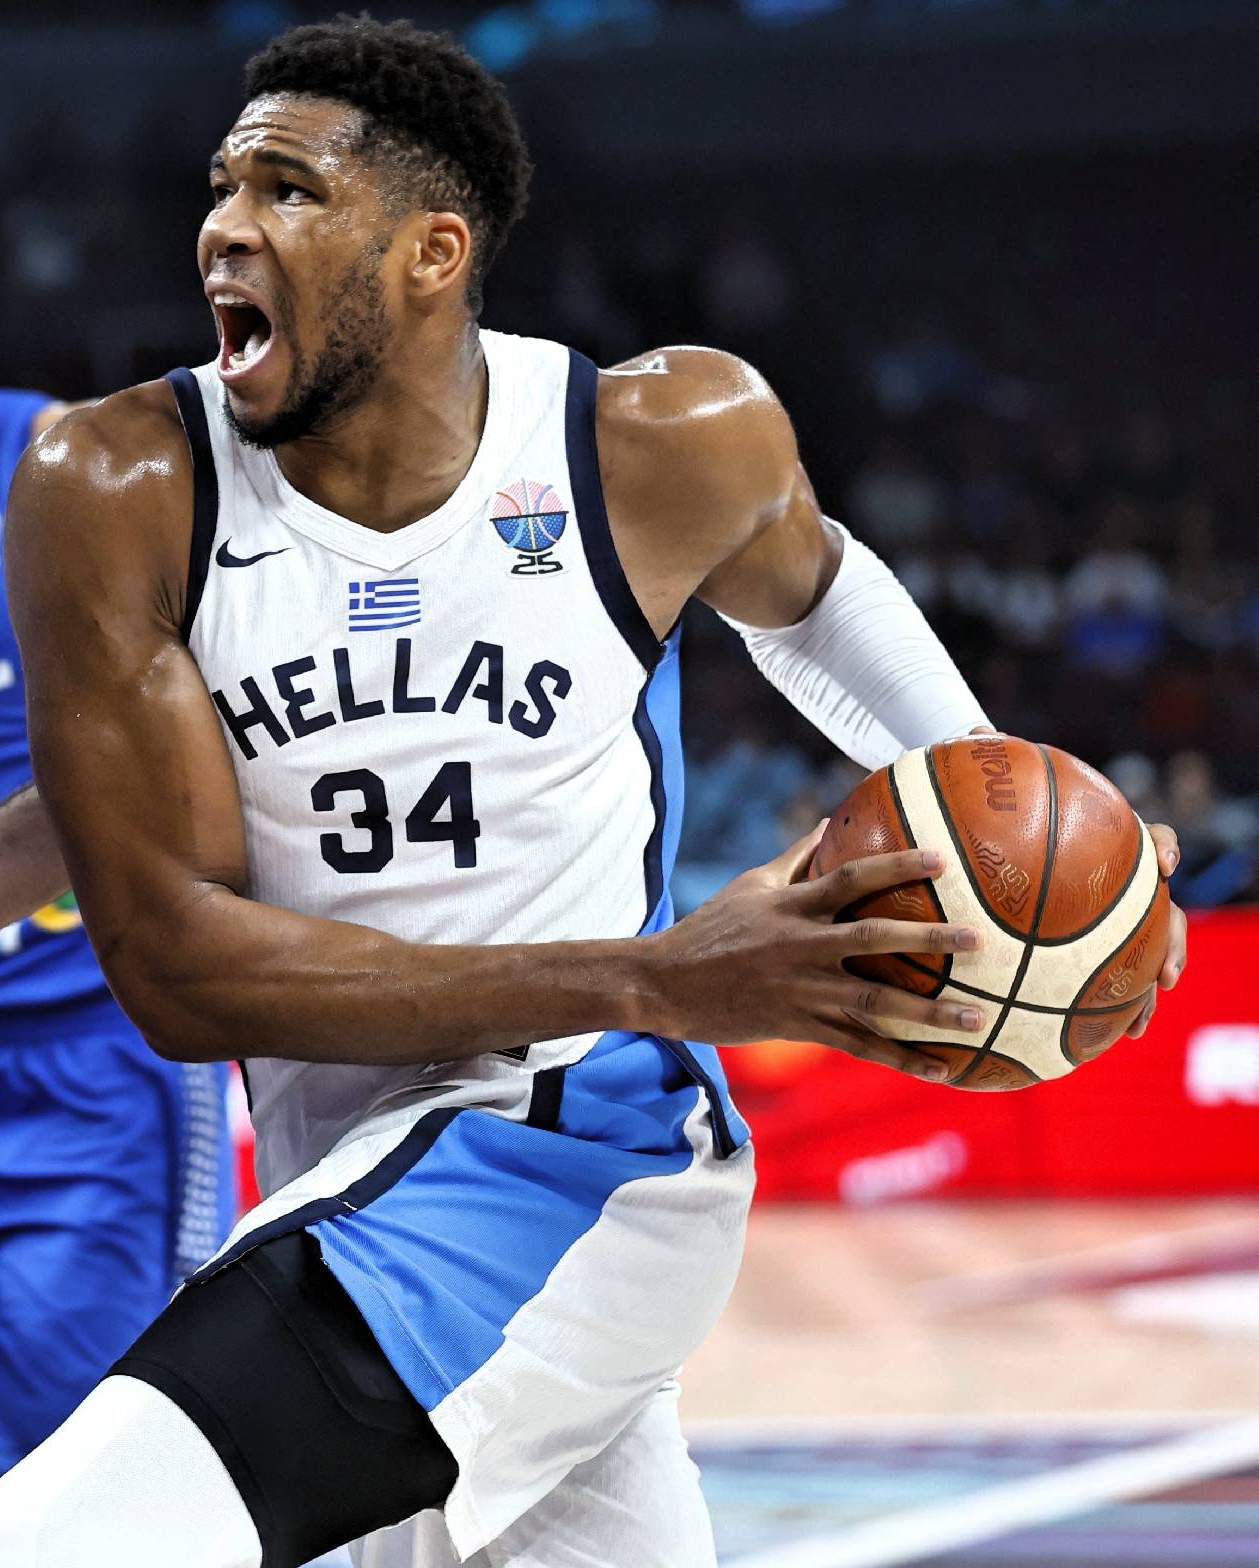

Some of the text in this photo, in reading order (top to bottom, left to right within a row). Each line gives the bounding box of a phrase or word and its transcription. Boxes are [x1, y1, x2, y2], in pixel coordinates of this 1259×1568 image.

[510, 551, 564, 575] 25
[211, 638, 573, 761] HELLAS
[310, 761, 481, 874] 34
